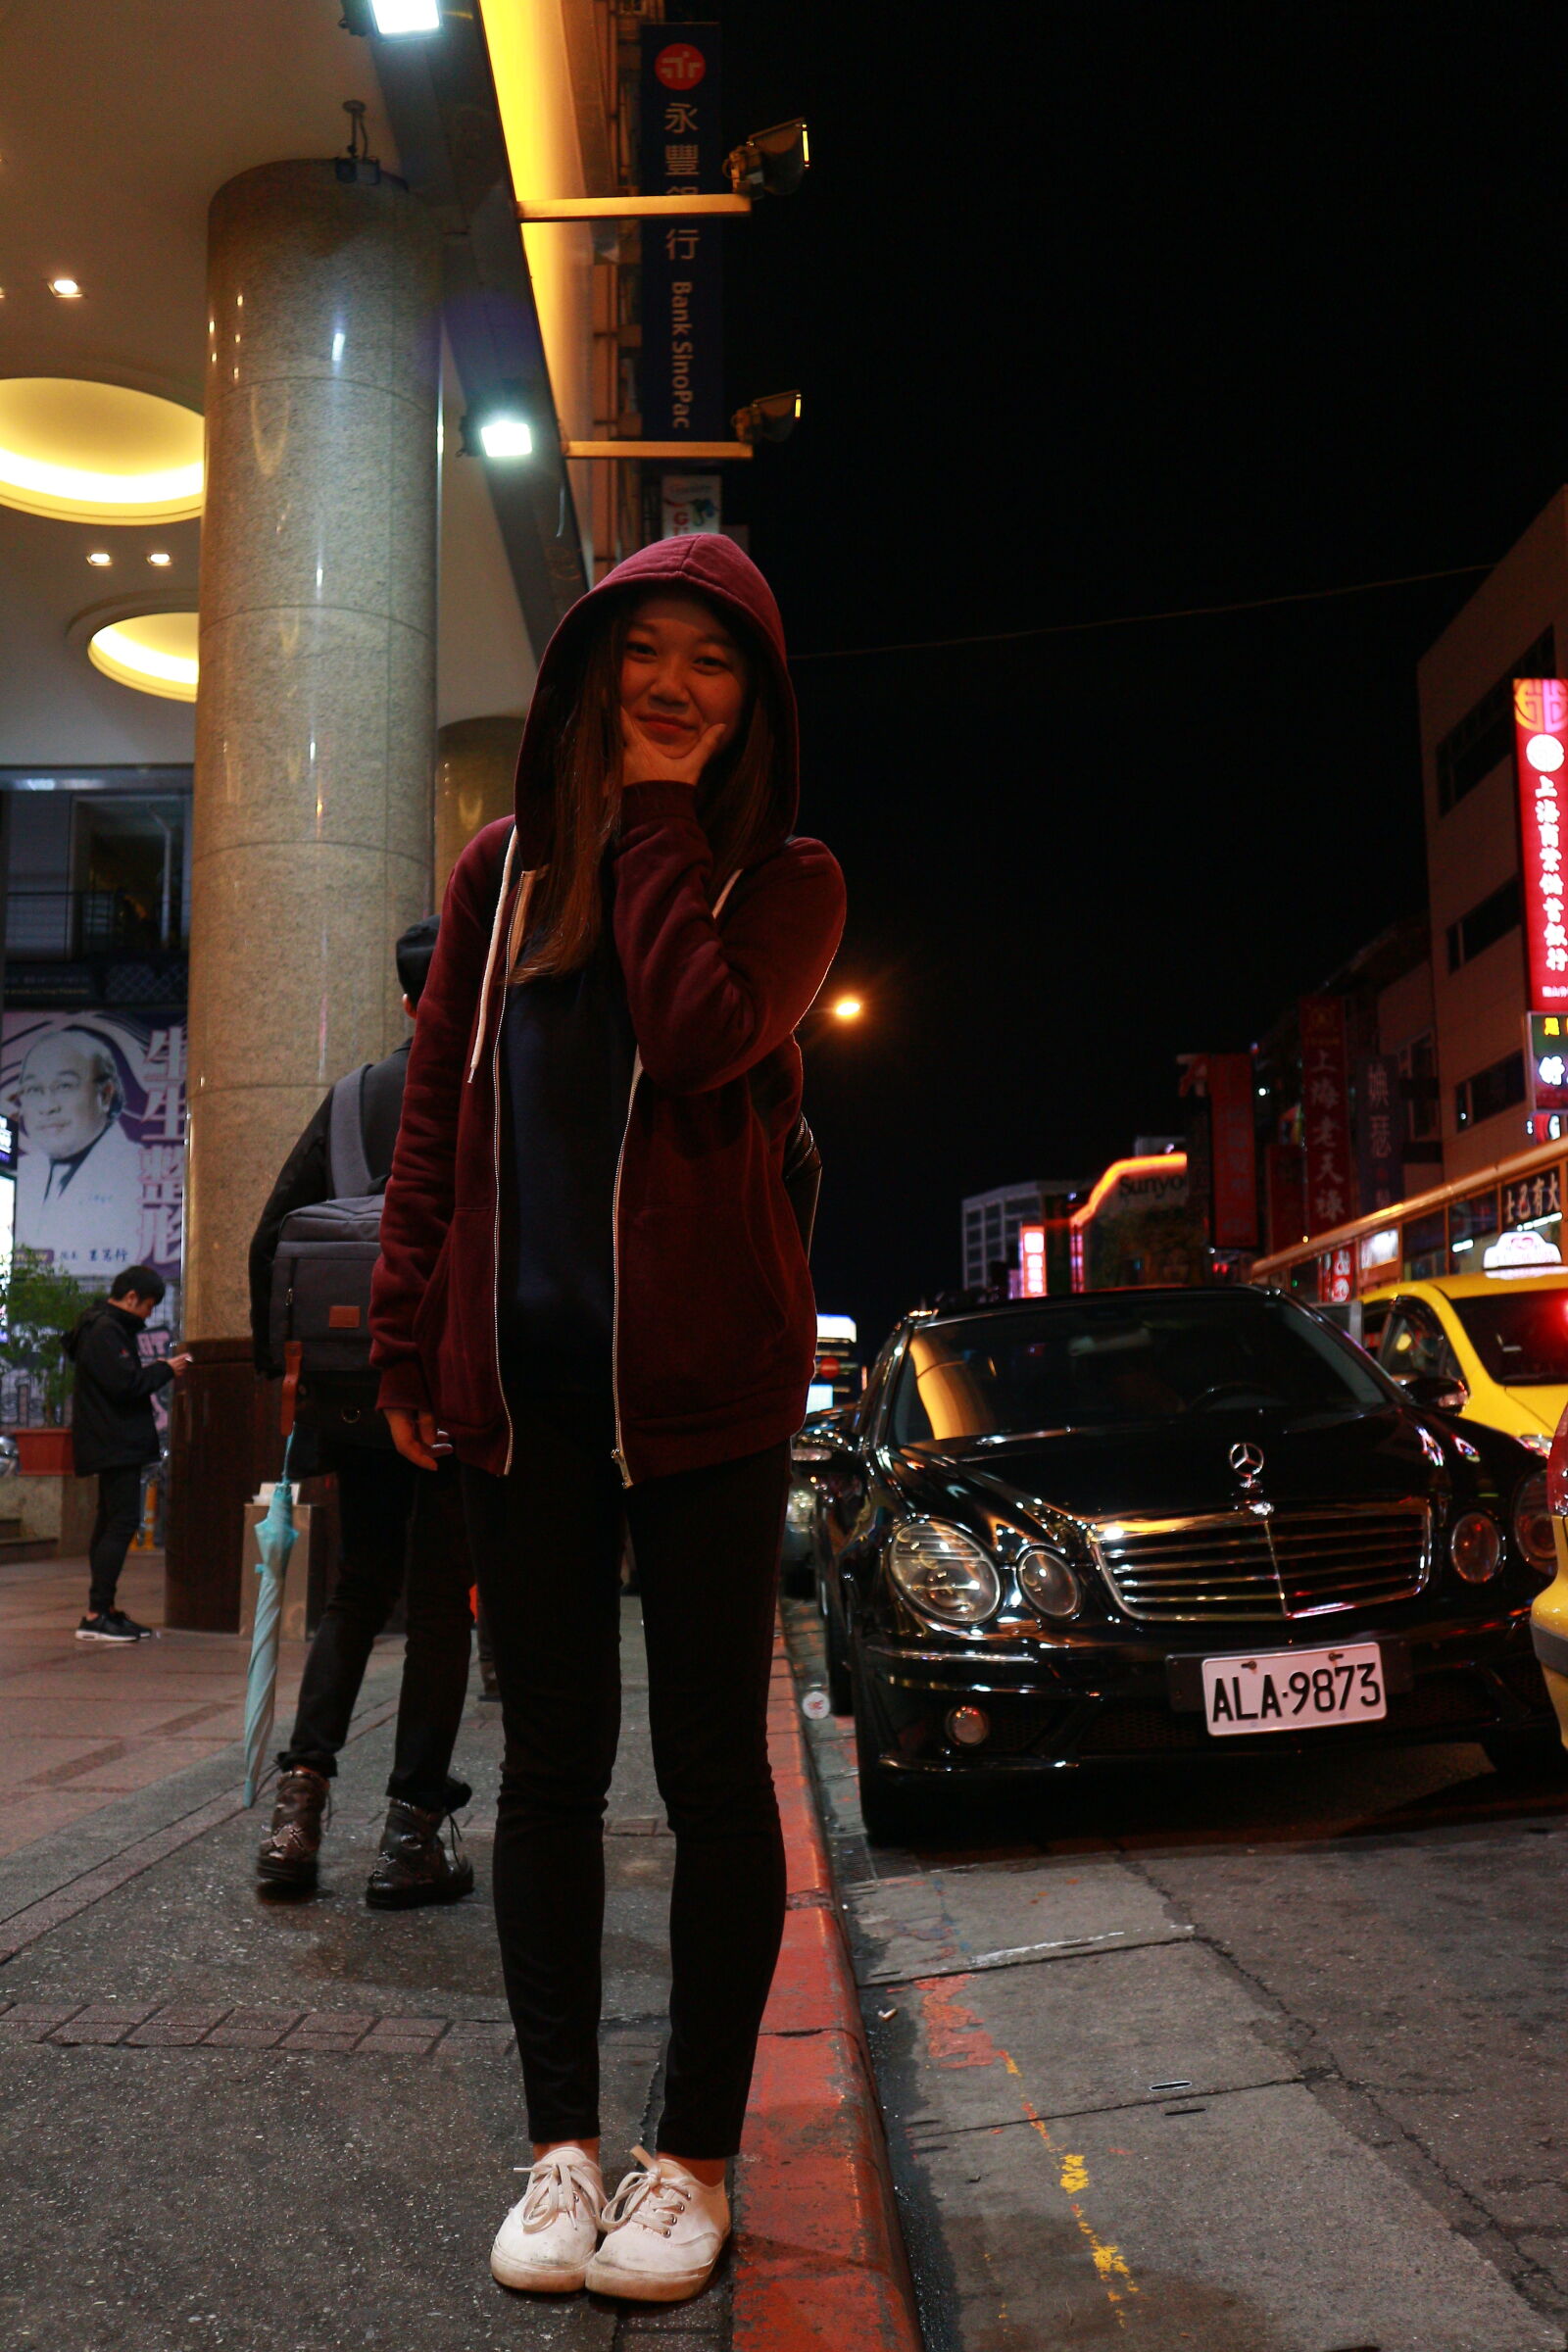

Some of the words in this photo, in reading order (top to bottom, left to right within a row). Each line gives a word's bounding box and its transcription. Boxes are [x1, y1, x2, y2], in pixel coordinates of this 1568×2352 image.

[663, 101, 702, 262] 永豐行
[671, 281, 694, 336] Bank
[671, 341, 695, 429] SinoPac
